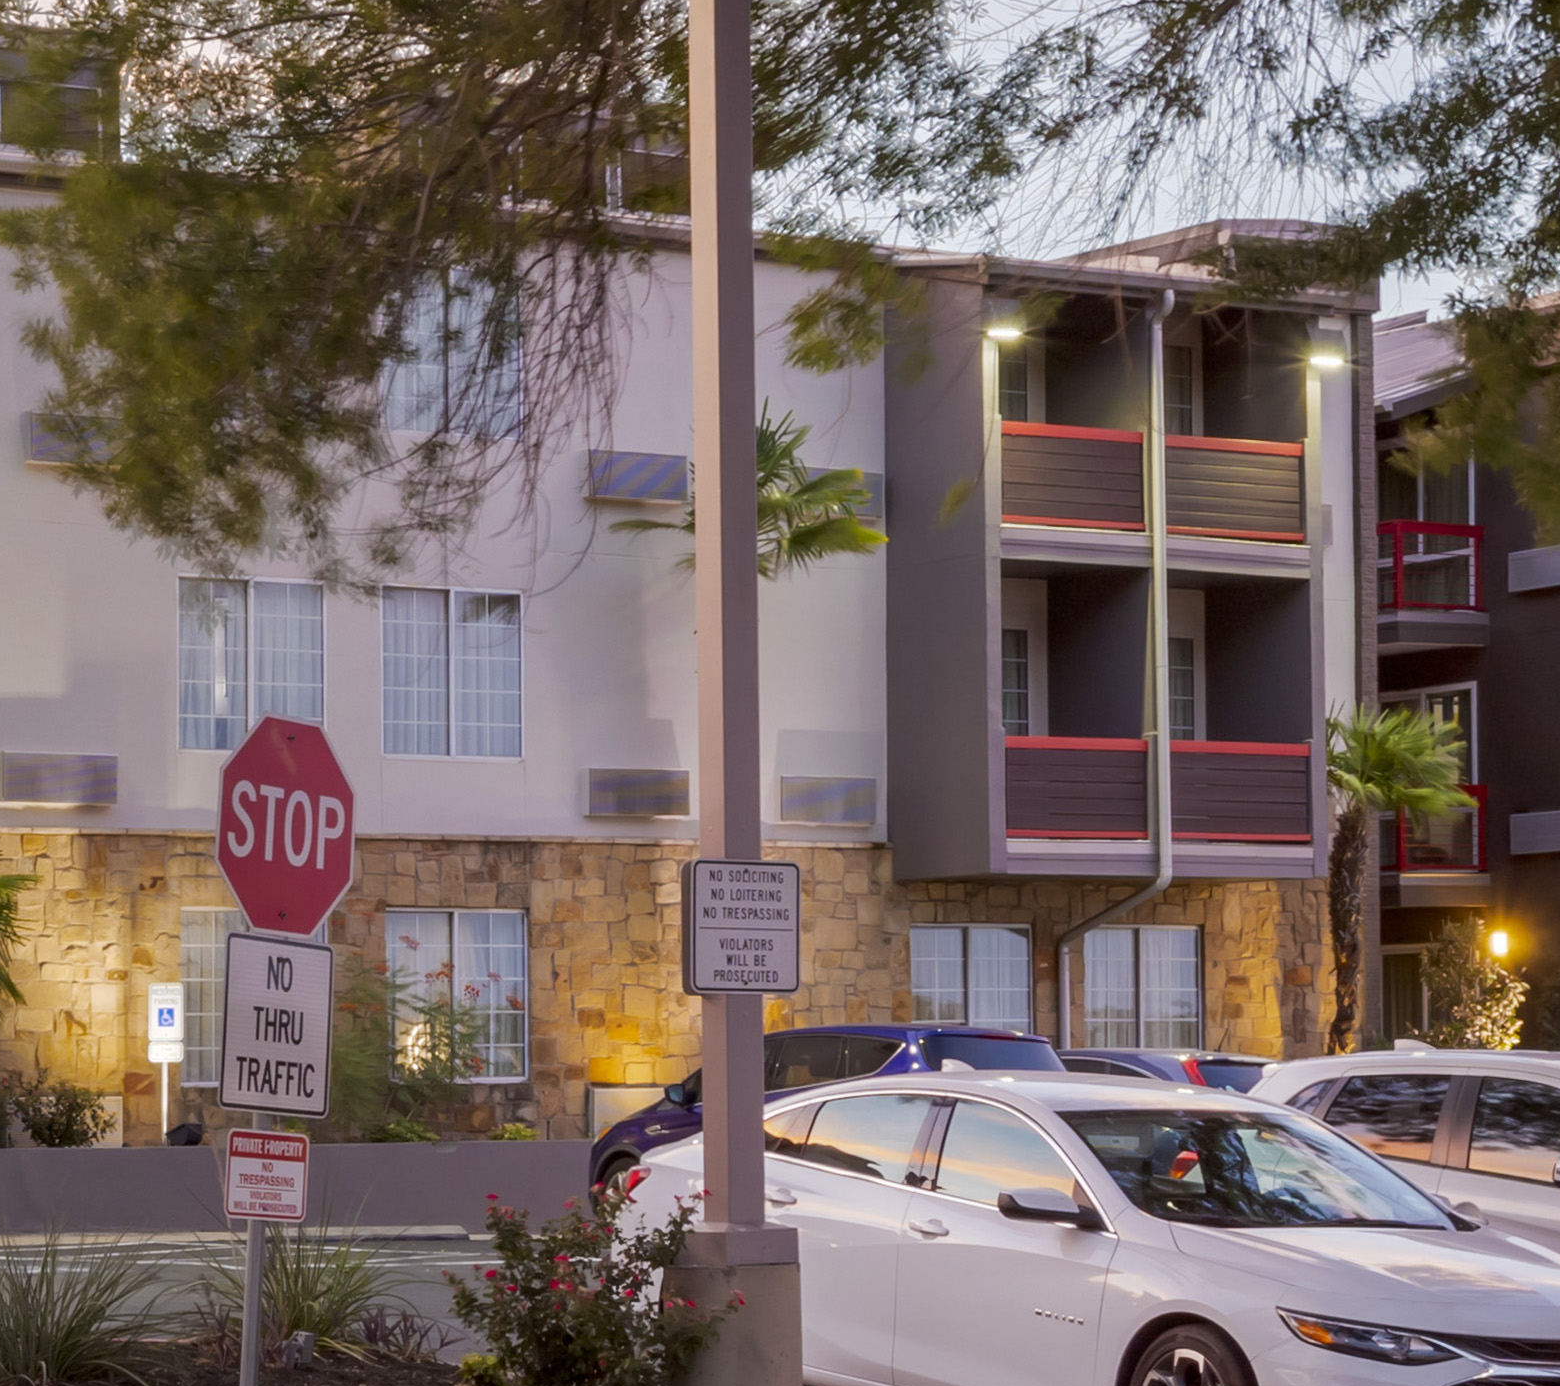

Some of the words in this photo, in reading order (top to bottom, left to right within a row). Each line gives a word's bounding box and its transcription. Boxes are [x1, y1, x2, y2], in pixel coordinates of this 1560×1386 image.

[227, 779, 345, 869] STOP
[709, 870, 723, 882] NO
[728, 870, 784, 884] SOLICITING
[710, 888, 725, 901] NO
[730, 889, 782, 902] LOITERING
[703, 907, 717, 919] NO
[722, 907, 790, 921] TRESPASSING
[719, 938, 774, 951] VIOLATORS
[726, 954, 748, 966] WILL
[754, 955, 767, 967] BE
[267, 955, 293, 992] NO
[713, 970, 779, 983] PROSECUTED
[253, 1006, 304, 1045] THRU
[236, 1056, 315, 1098] TRAFFIC
[232, 1137, 263, 1154] PRIVATE
[264, 1139, 304, 1157] PROPERTY
[261, 1162, 274, 1173] NO
[238, 1173, 295, 1188] TRESPASSING
[249, 1191, 282, 1201] VIOLATORS
[233, 1201, 247, 1210] WILL
[249, 1202, 257, 1211] BE
[258, 1202, 298, 1214] PROSECUTED
